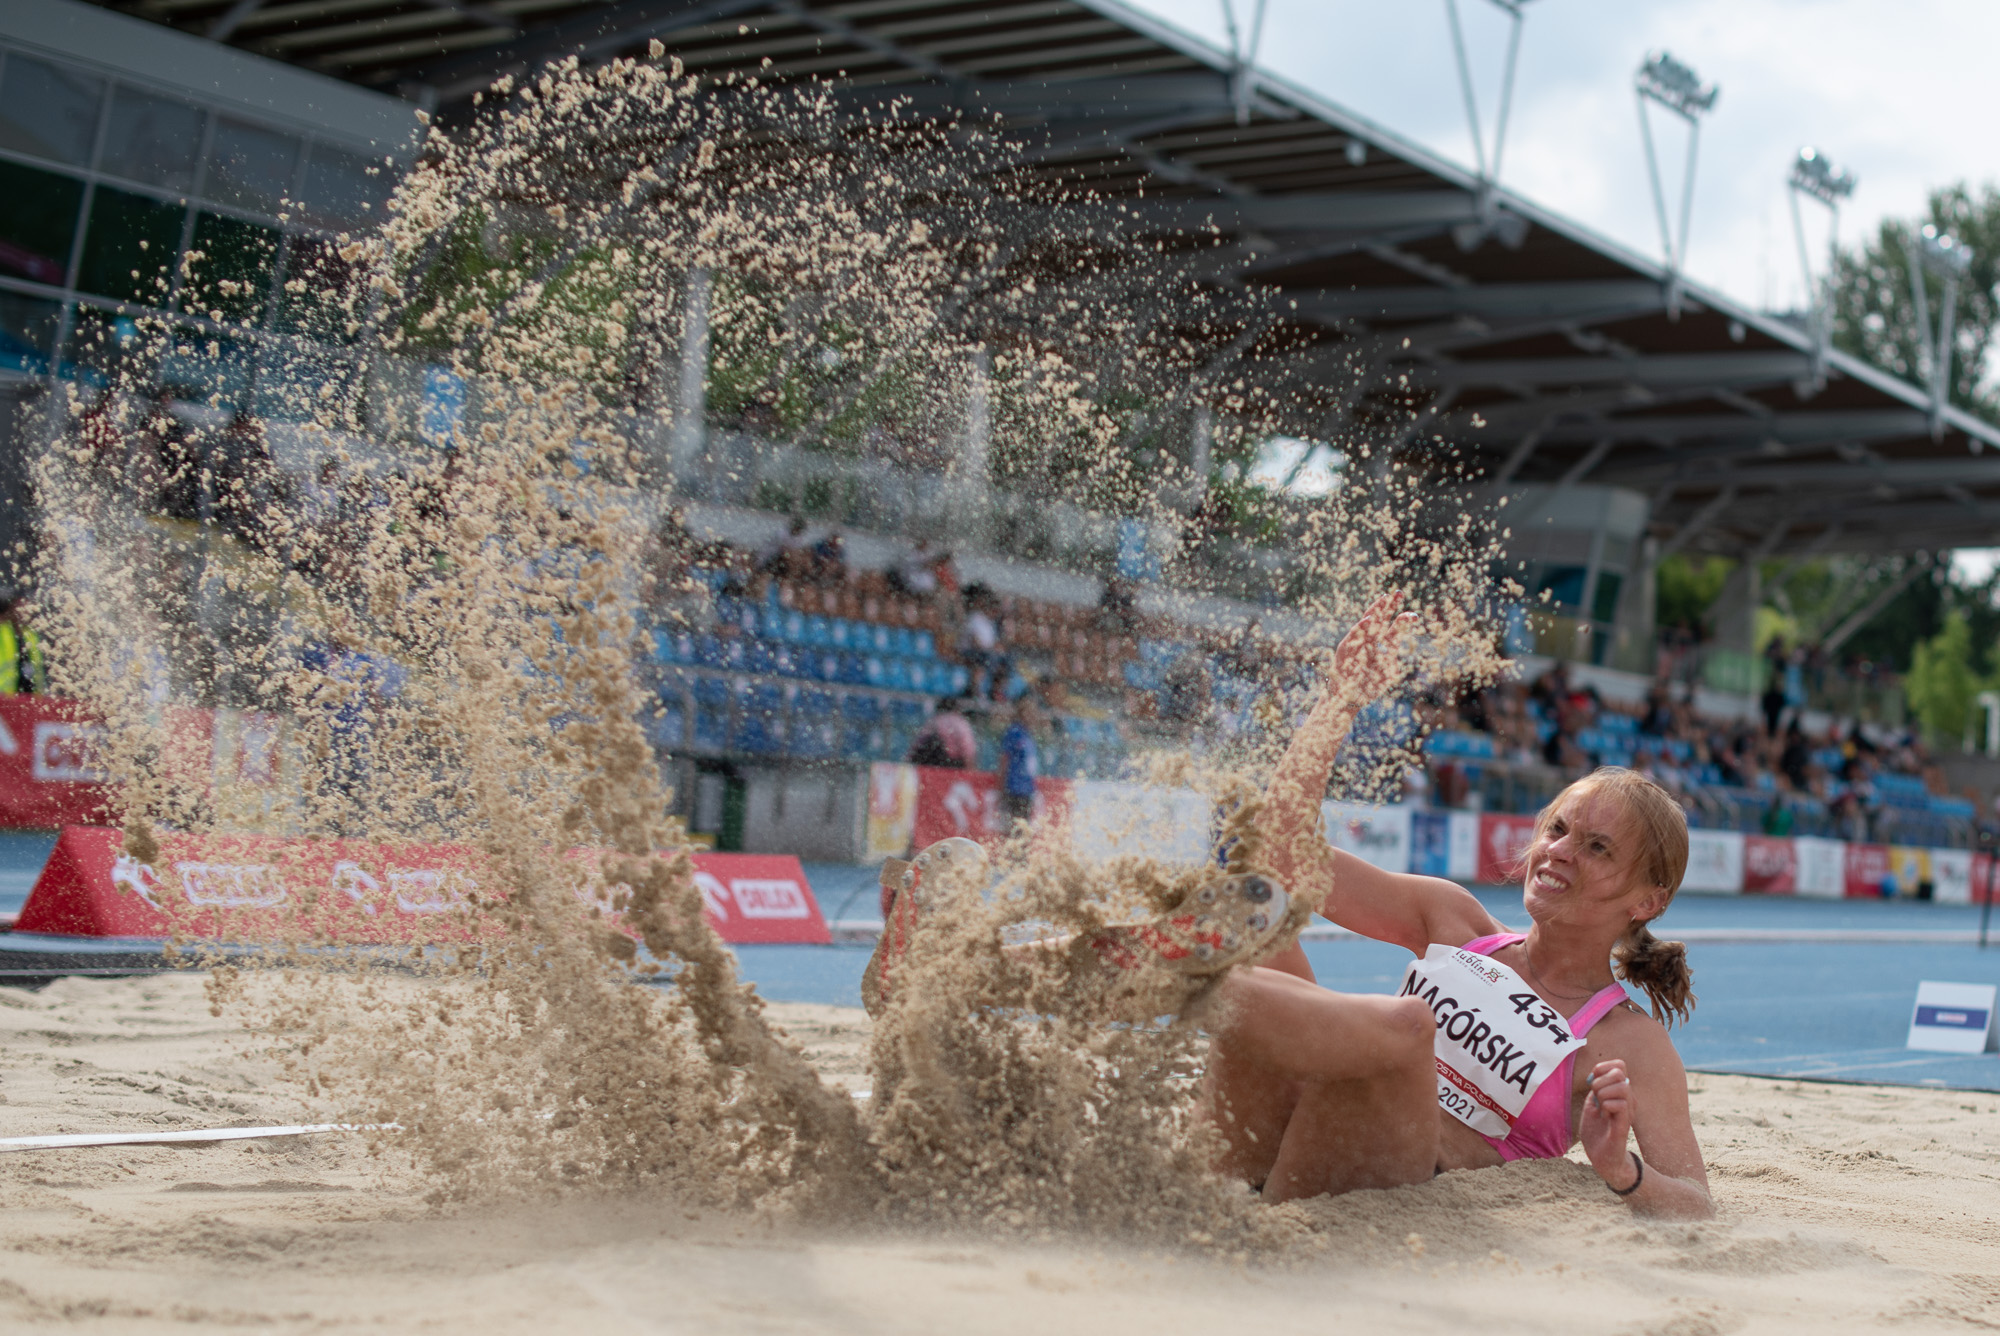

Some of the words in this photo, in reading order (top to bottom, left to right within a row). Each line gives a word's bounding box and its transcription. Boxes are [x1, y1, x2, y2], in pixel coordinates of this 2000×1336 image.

[1400, 969, 1537, 1095] NAGÓRSKA
[1508, 993, 1570, 1045] 434
[1434, 1061, 1463, 1087] OSTWA
[1463, 1082, 1492, 1107] POLSKI
[1438, 1086, 1475, 1120] 2021
